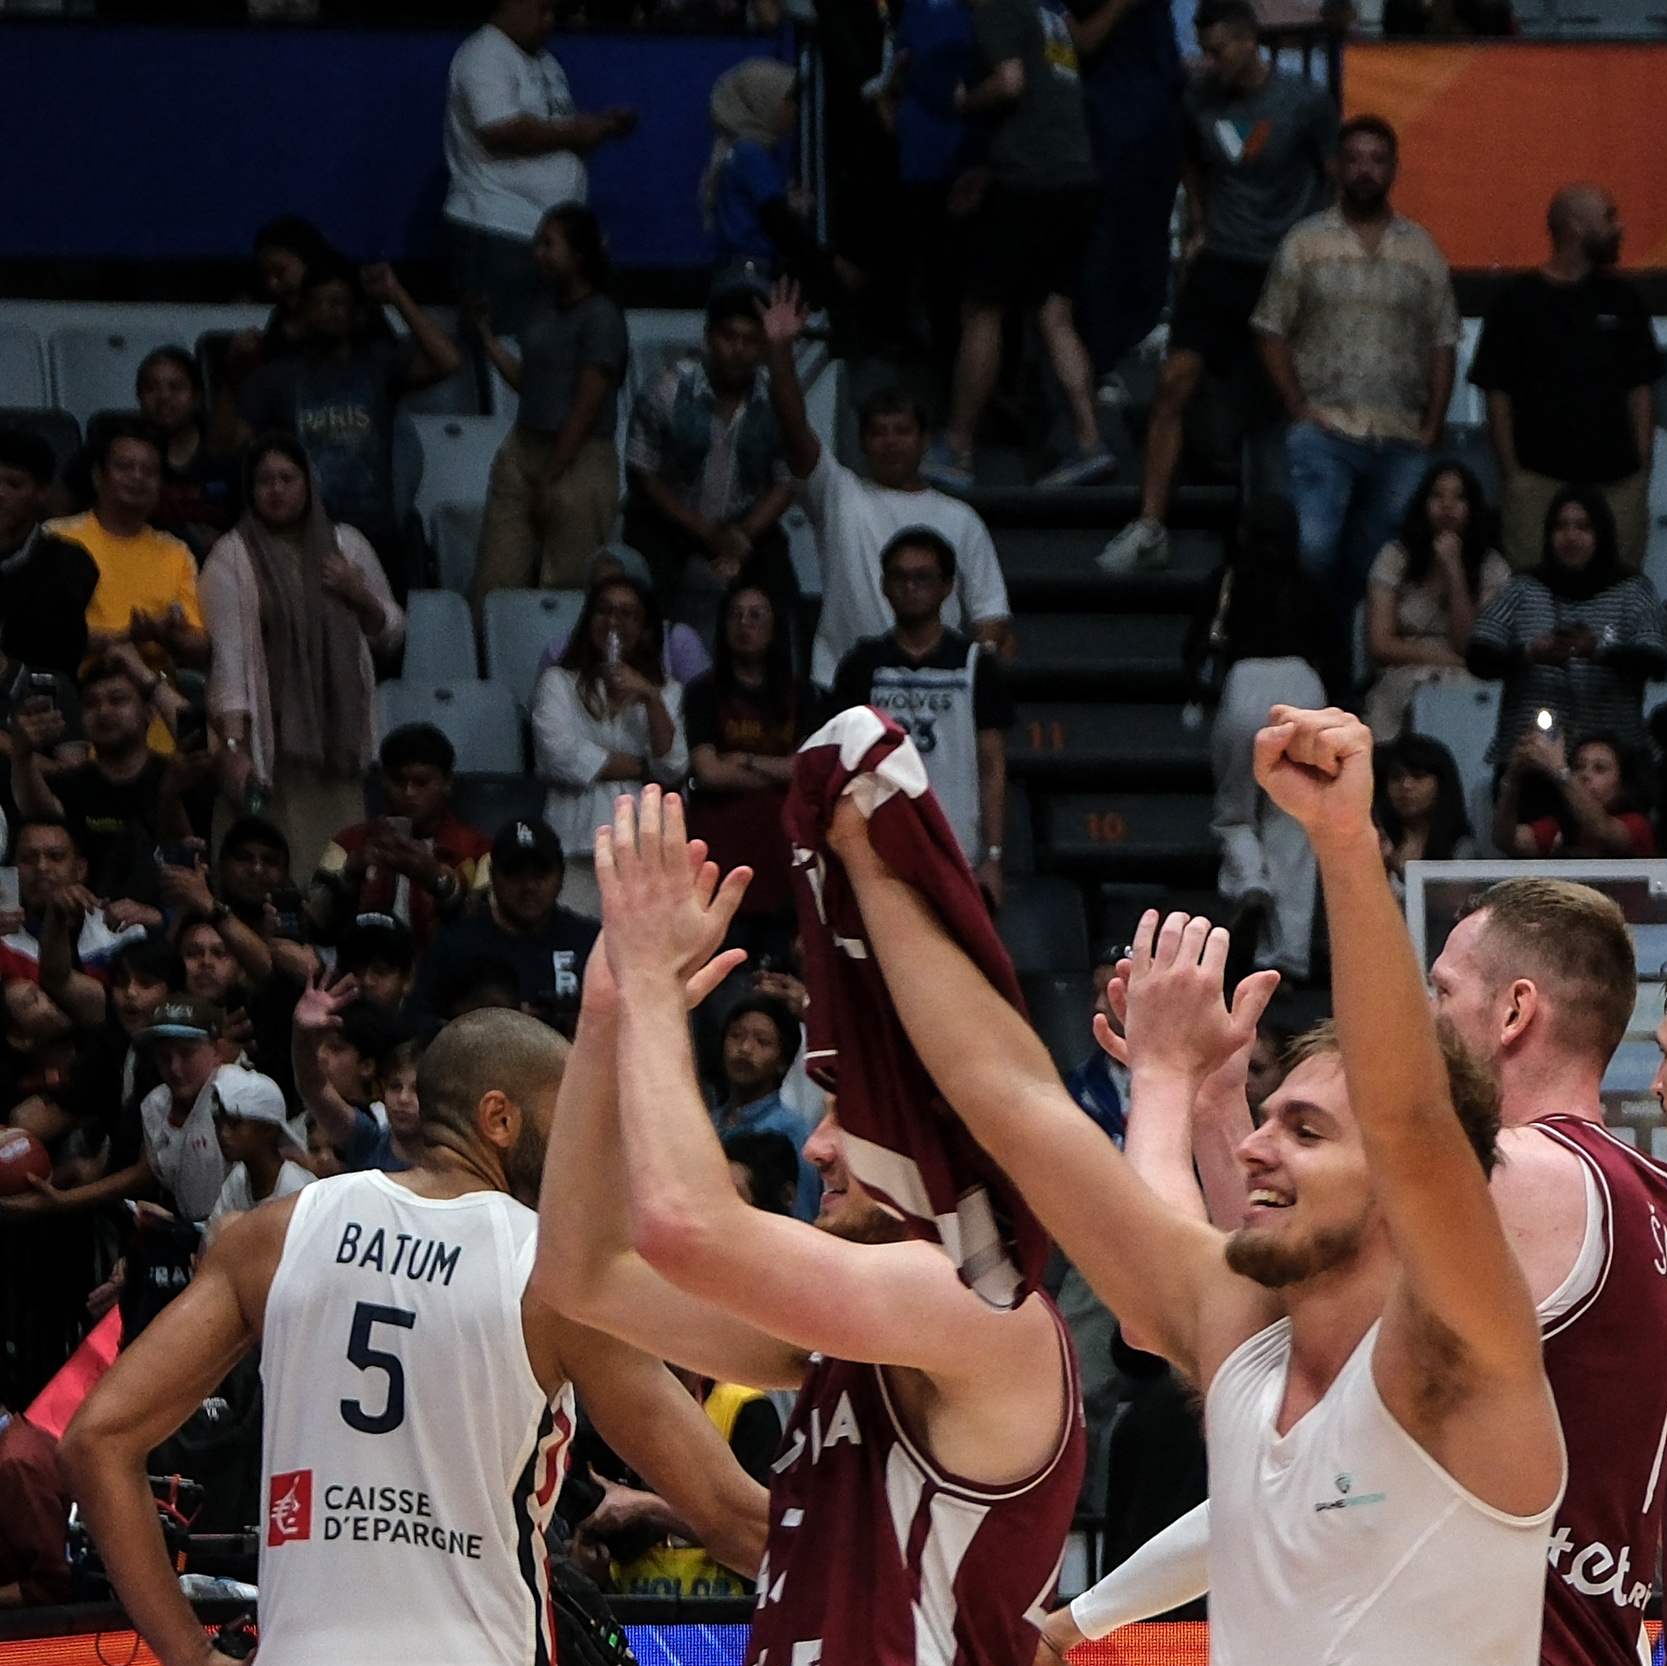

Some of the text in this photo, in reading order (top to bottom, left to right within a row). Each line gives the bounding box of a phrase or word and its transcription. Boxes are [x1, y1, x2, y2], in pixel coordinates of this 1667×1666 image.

[335, 1221, 462, 1287] BATUM
[339, 1300, 417, 1435] 5
[324, 1484, 433, 1518] CAISSE
[322, 1515, 483, 1560] D'EPARGNE
